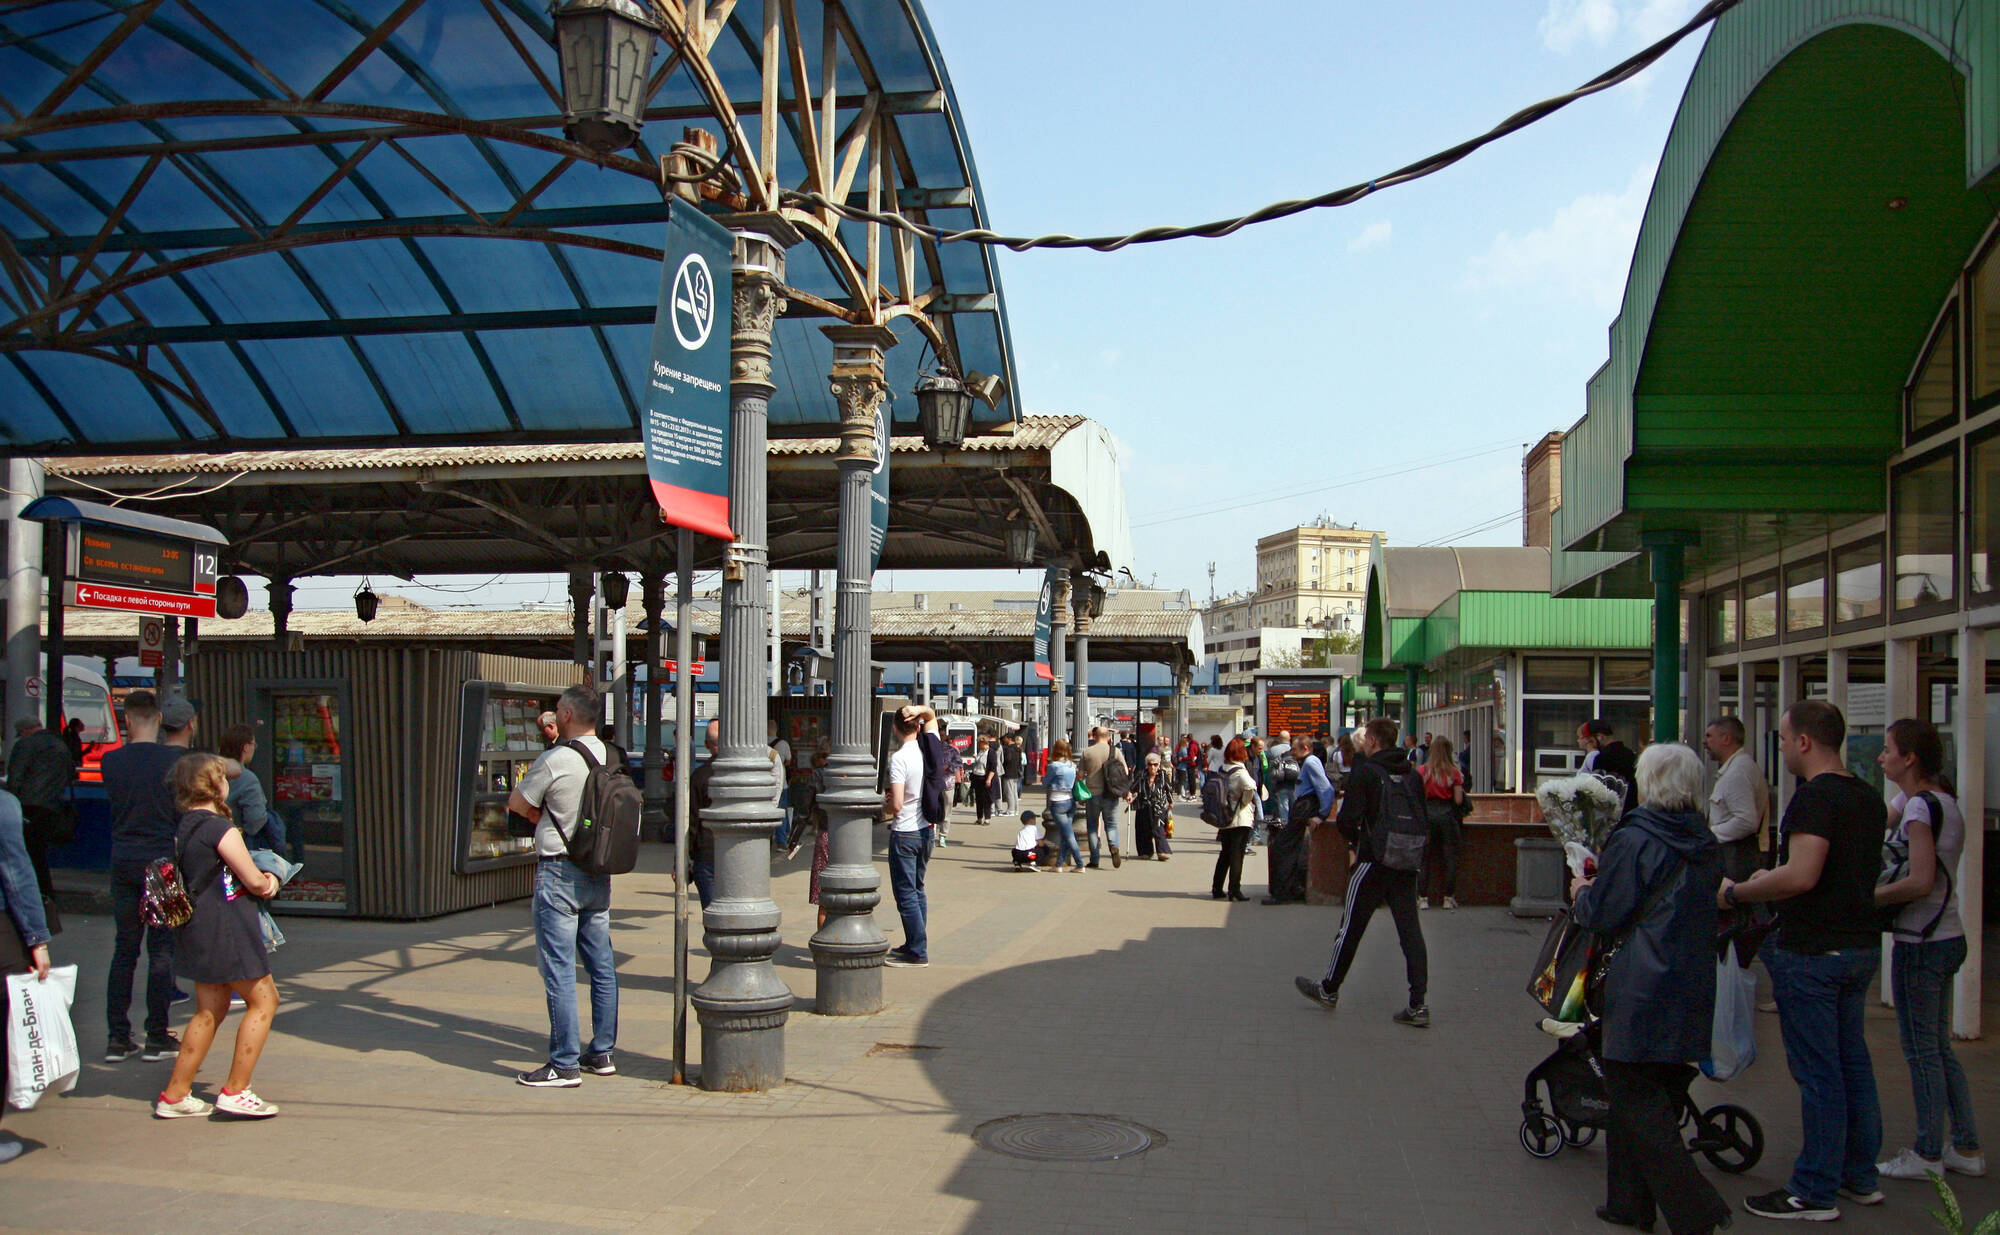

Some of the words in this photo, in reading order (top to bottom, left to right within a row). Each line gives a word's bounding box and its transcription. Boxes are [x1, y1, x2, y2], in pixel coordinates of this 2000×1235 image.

[652, 379, 659, 387] No
[658, 381, 675, 394] smoking
[654, 360, 681, 380] Курение
[682, 373, 722, 393] запрещено
[198, 554, 215, 575] 12
[93, 591, 122, 603] Посадка
[127, 596, 148, 605] левой
[148, 599, 176, 608] стороны
[176, 602, 191, 611] пути
